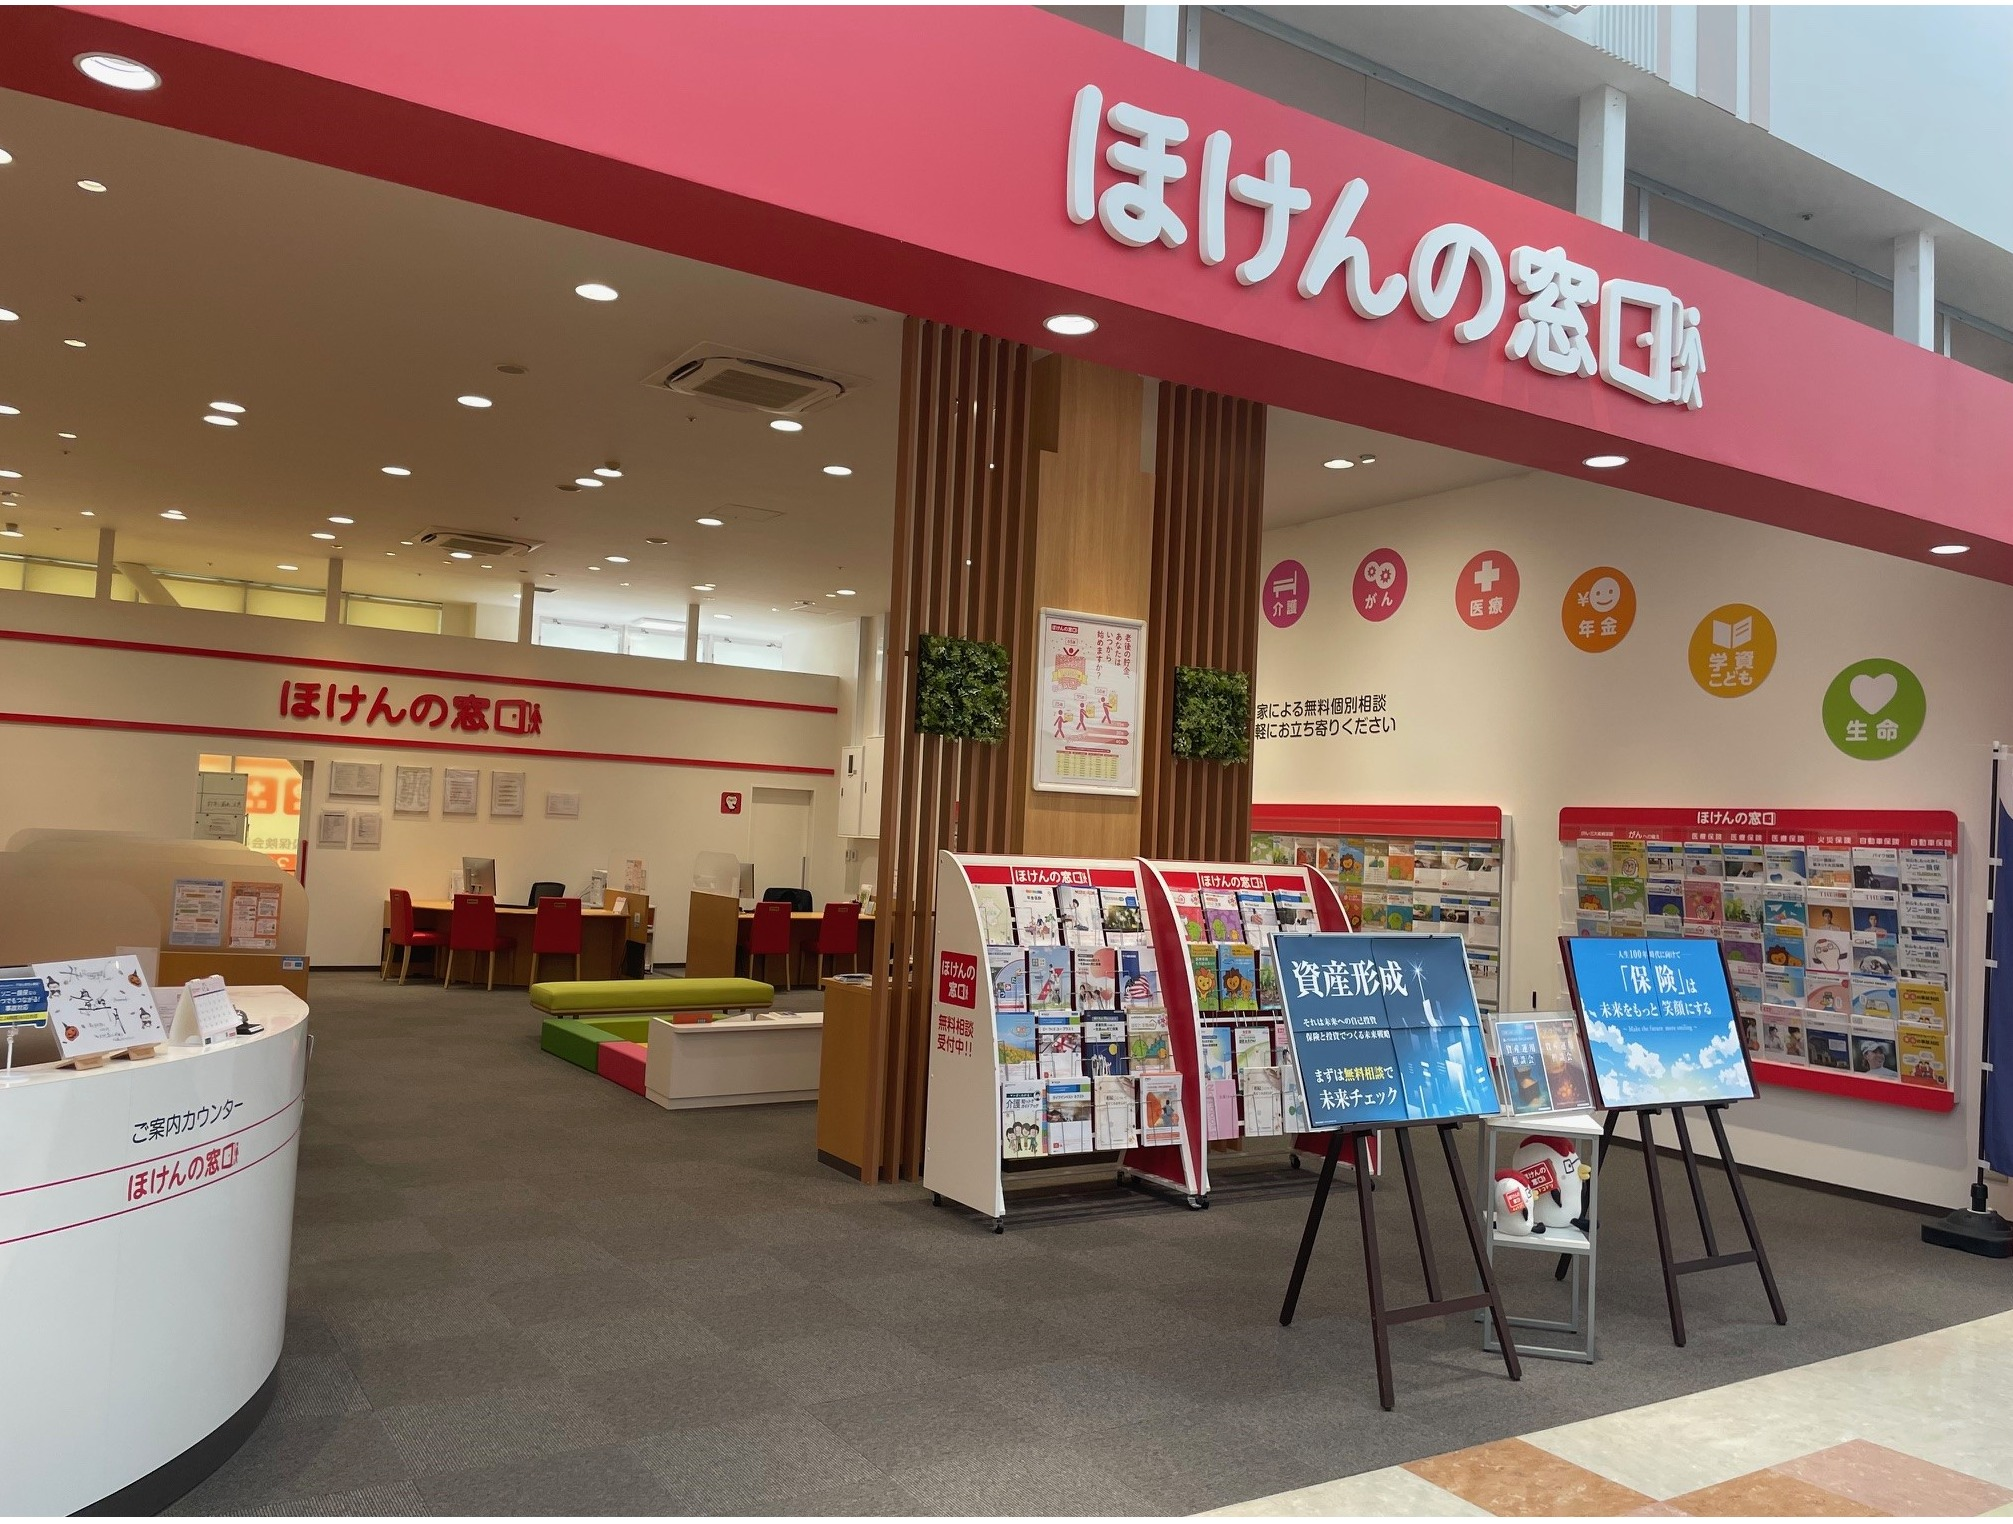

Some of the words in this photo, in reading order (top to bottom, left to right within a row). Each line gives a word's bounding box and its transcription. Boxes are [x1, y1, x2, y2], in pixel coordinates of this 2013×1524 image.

[1066, 84, 1684, 404] ほけんの窓口
[1272, 599, 1298, 617] 介護
[1364, 591, 1393, 609] がん
[1469, 596, 1504, 616] 医療
[1578, 616, 1618, 638] 年金
[1106, 631, 1114, 663] いつから
[1114, 632, 1123, 667] あなたは
[1708, 651, 1754, 672] 学資
[1708, 670, 1753, 687] こども
[280, 680, 530, 735] ほけんの窓口
[1256, 694, 1387, 719] 家による無料個別相談
[1254, 716, 1396, 740] 軽にお立ち寄りください
[1845, 719, 1899, 741] 生命
[1697, 811, 1776, 825] ほけんの窓口
[1817, 835, 1852, 844] 火災保険
[1859, 837, 1900, 846] 自動車保険
[1910, 838, 1952, 847] 自動車保険
[1015, 869, 1085, 885] ほけんの窓口
[1201, 875, 1262, 889] ほけんの窓口
[941, 959, 976, 980] ほけんの
[1292, 959, 1409, 998] 資産形成
[1620, 963, 1698, 996] 「保険」は
[948, 981, 967, 1000] 窓口
[938, 1014, 974, 1038] 無料相談
[1303, 1016, 1378, 1028] それは未来への自己投資
[1305, 1030, 1391, 1042] 保険と投資でつくる未来戦略
[1315, 1066, 1394, 1083] まずは無料相談で
[1319, 1086, 1398, 1111] 未来チェック
[132, 1099, 244, 1143] ご案内カウンター
[127, 1142, 237, 1201] ほけんの窓口
